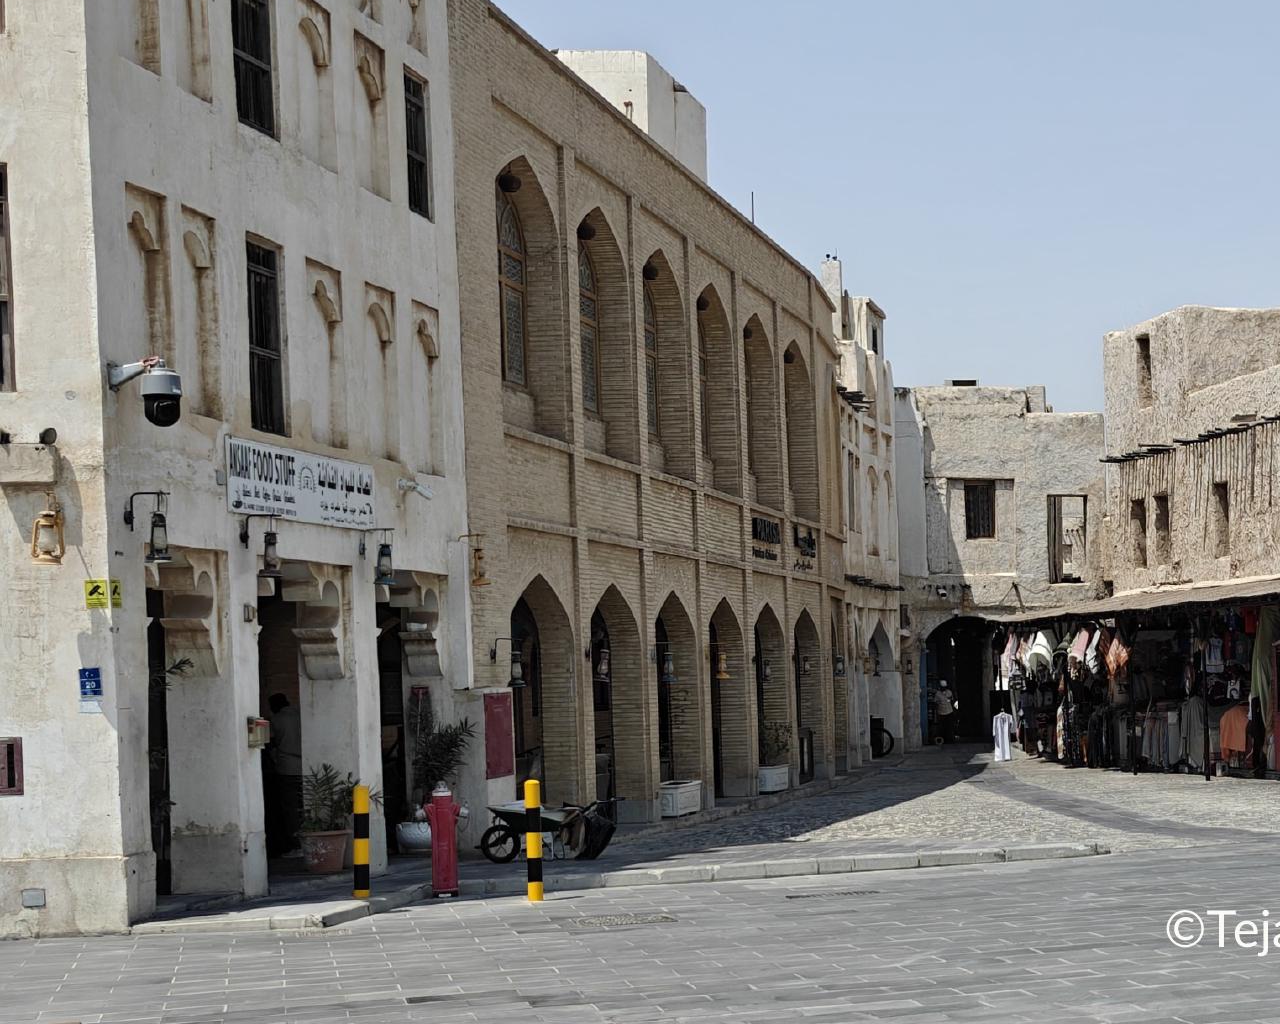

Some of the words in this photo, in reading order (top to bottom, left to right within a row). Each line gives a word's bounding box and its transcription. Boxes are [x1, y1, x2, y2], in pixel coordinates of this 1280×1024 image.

[252, 448, 273, 484] FOOD
[274, 453, 296, 487] STUFF
[85, 681, 96, 689] 20
